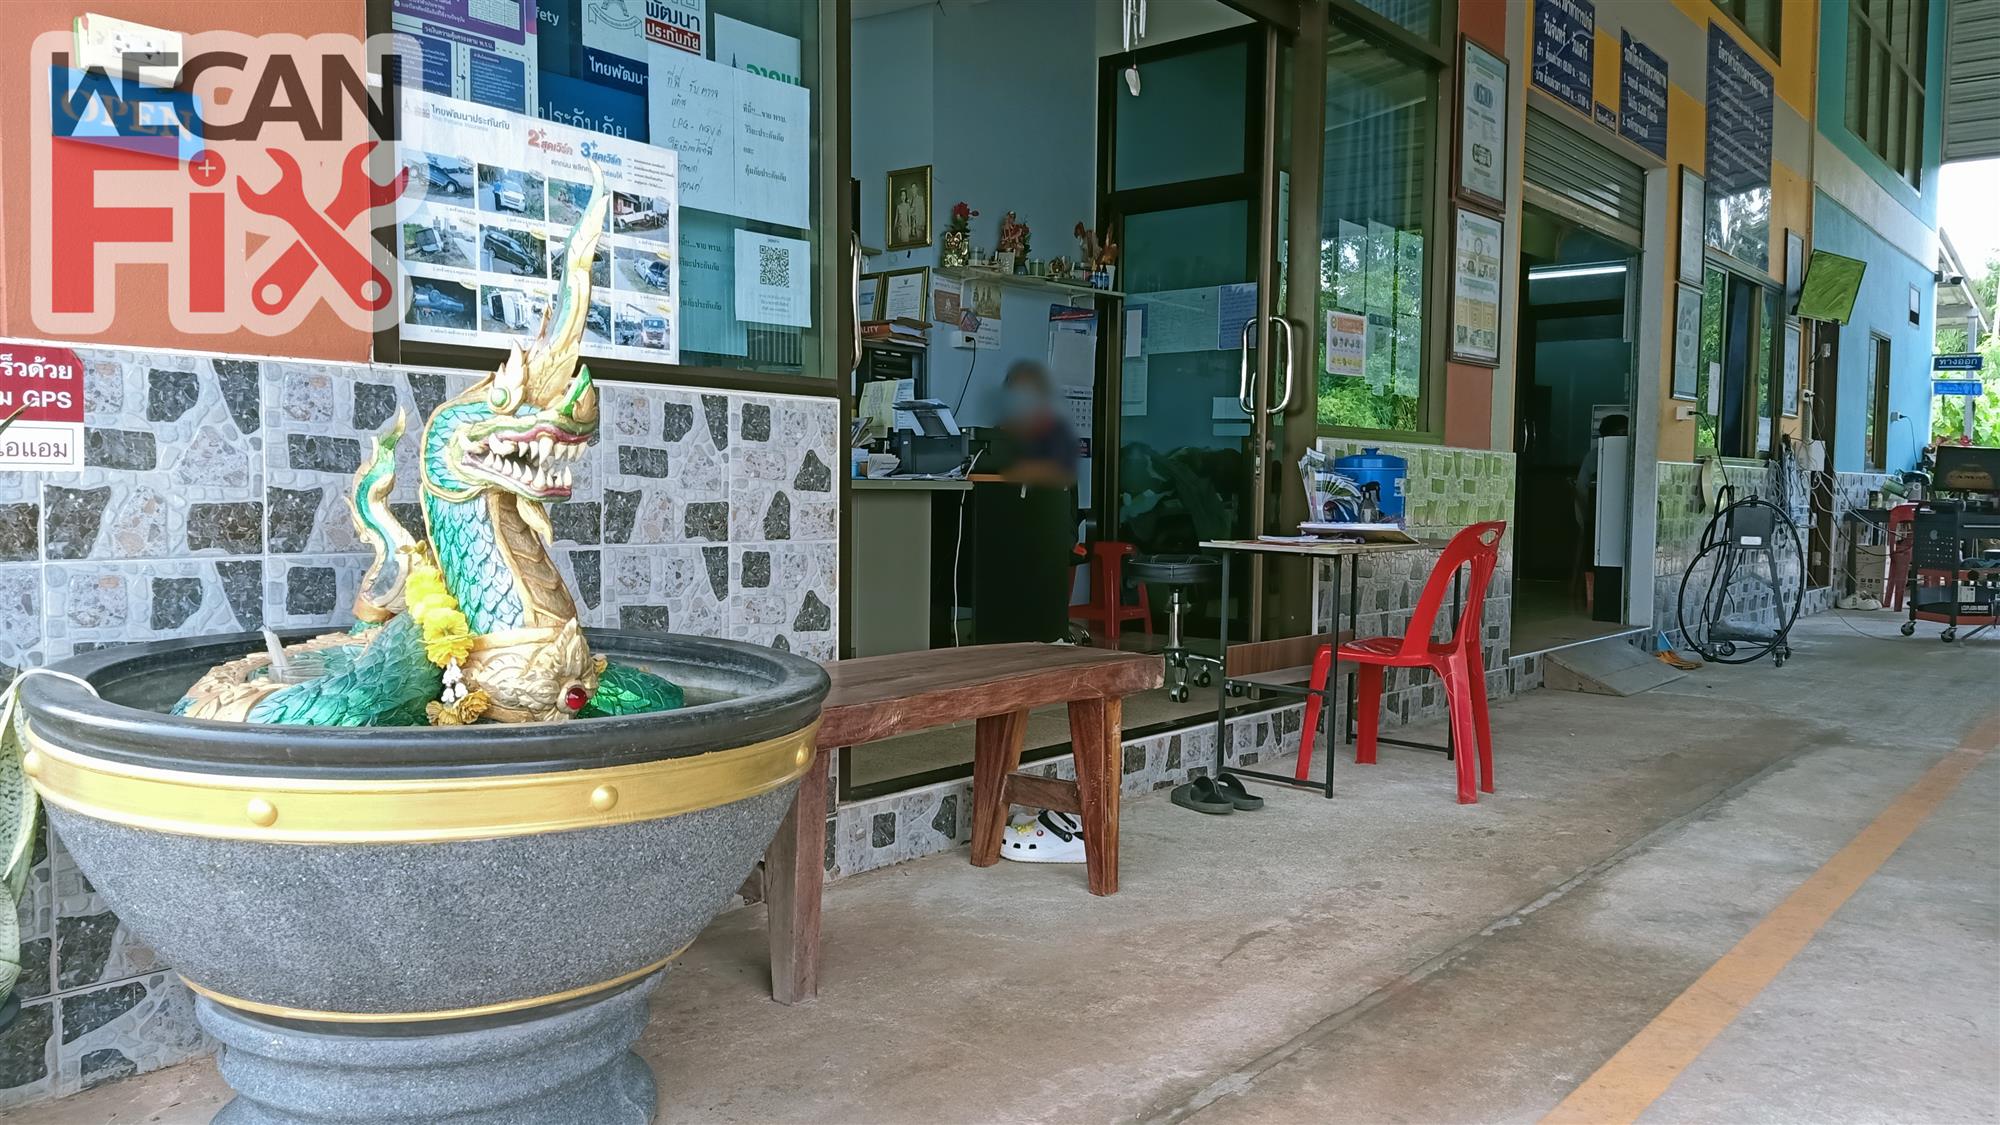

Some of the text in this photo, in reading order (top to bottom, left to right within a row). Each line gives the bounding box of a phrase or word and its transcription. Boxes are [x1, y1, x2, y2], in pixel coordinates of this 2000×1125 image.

[61, 88, 193, 142] OPEN
[22, 389, 72, 409] GPS
[0, 441, 67, 458] อแอม
